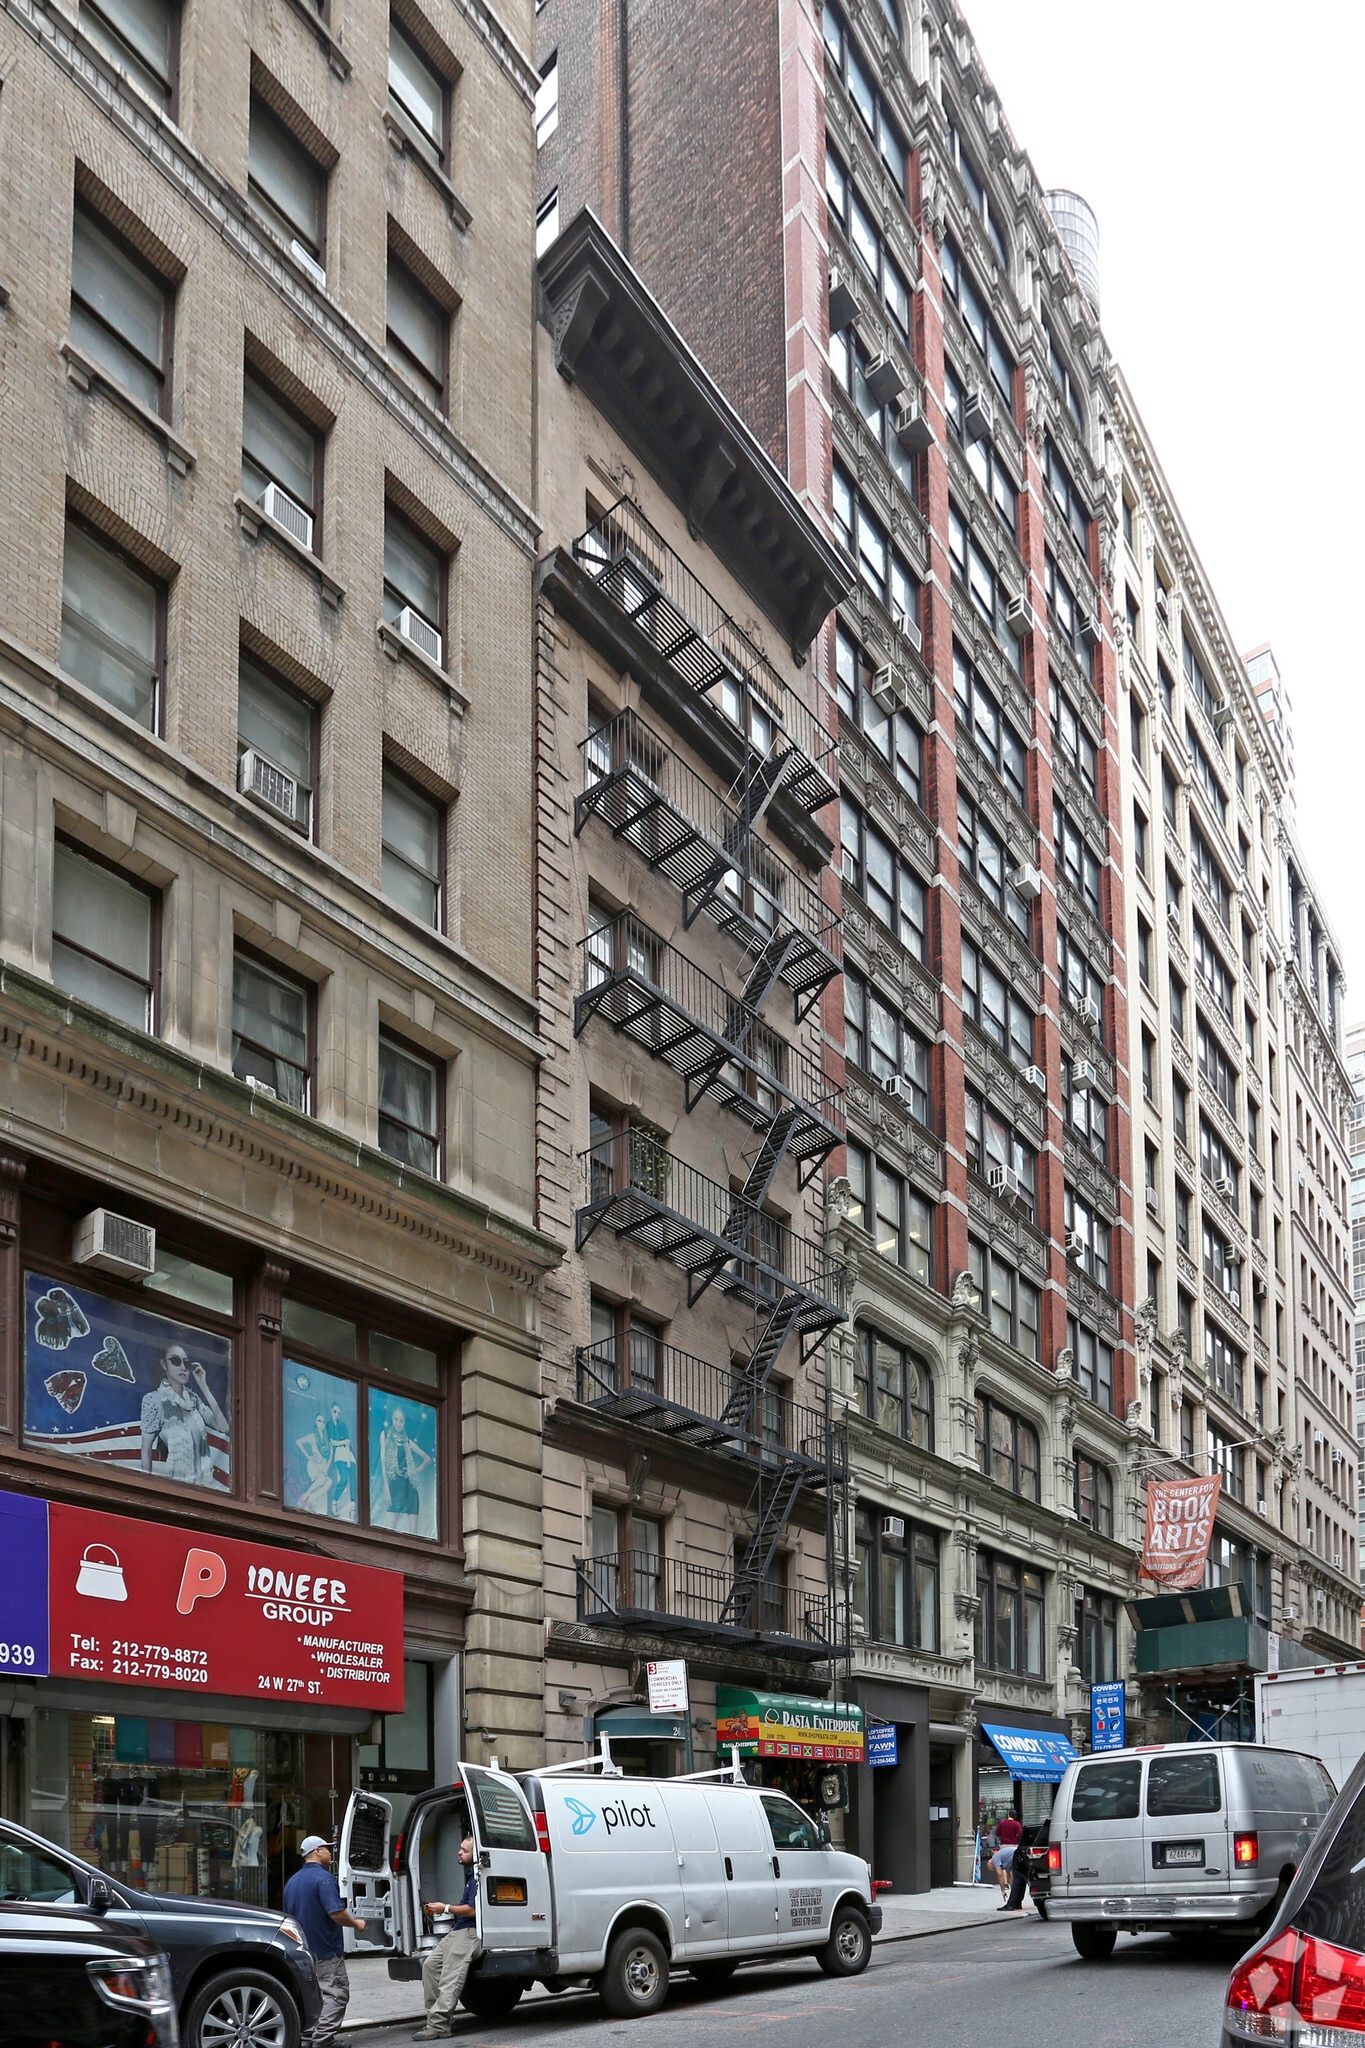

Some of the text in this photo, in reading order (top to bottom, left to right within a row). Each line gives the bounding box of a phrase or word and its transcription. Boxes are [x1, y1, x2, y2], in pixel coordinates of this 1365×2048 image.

[1155, 1483, 1214, 1498] THE CENTER FOR
[1153, 1493, 1214, 1523] BOOK
[1149, 1519, 1210, 1550] ARTS
[248, 1565, 346, 1605] IONEER
[262, 1602, 334, 1627] GROUP
[70, 1633, 208, 1665] Tel: 212-779-8872
[303, 1635, 384, 1655] MANUFACTURER
[70, 1652, 208, 1684] Fax: 212-779-8020
[316, 1651, 384, 1669] WHOLESALER
[649, 1664, 656, 1674] 3
[326, 1666, 391, 1684] DISTRIBUTOR
[258, 1676, 324, 1695] 24 W 27th ST.
[1092, 1682, 1124, 1692] COWBOY
[782, 1710, 860, 1735] RASTA ENTERPRISE
[868, 1742, 895, 1750] FAWN
[993, 1734, 1042, 1753] COWBOY
[601, 1800, 656, 1835] pilot
[800, 1896, 822, 1906] BROADWAY
